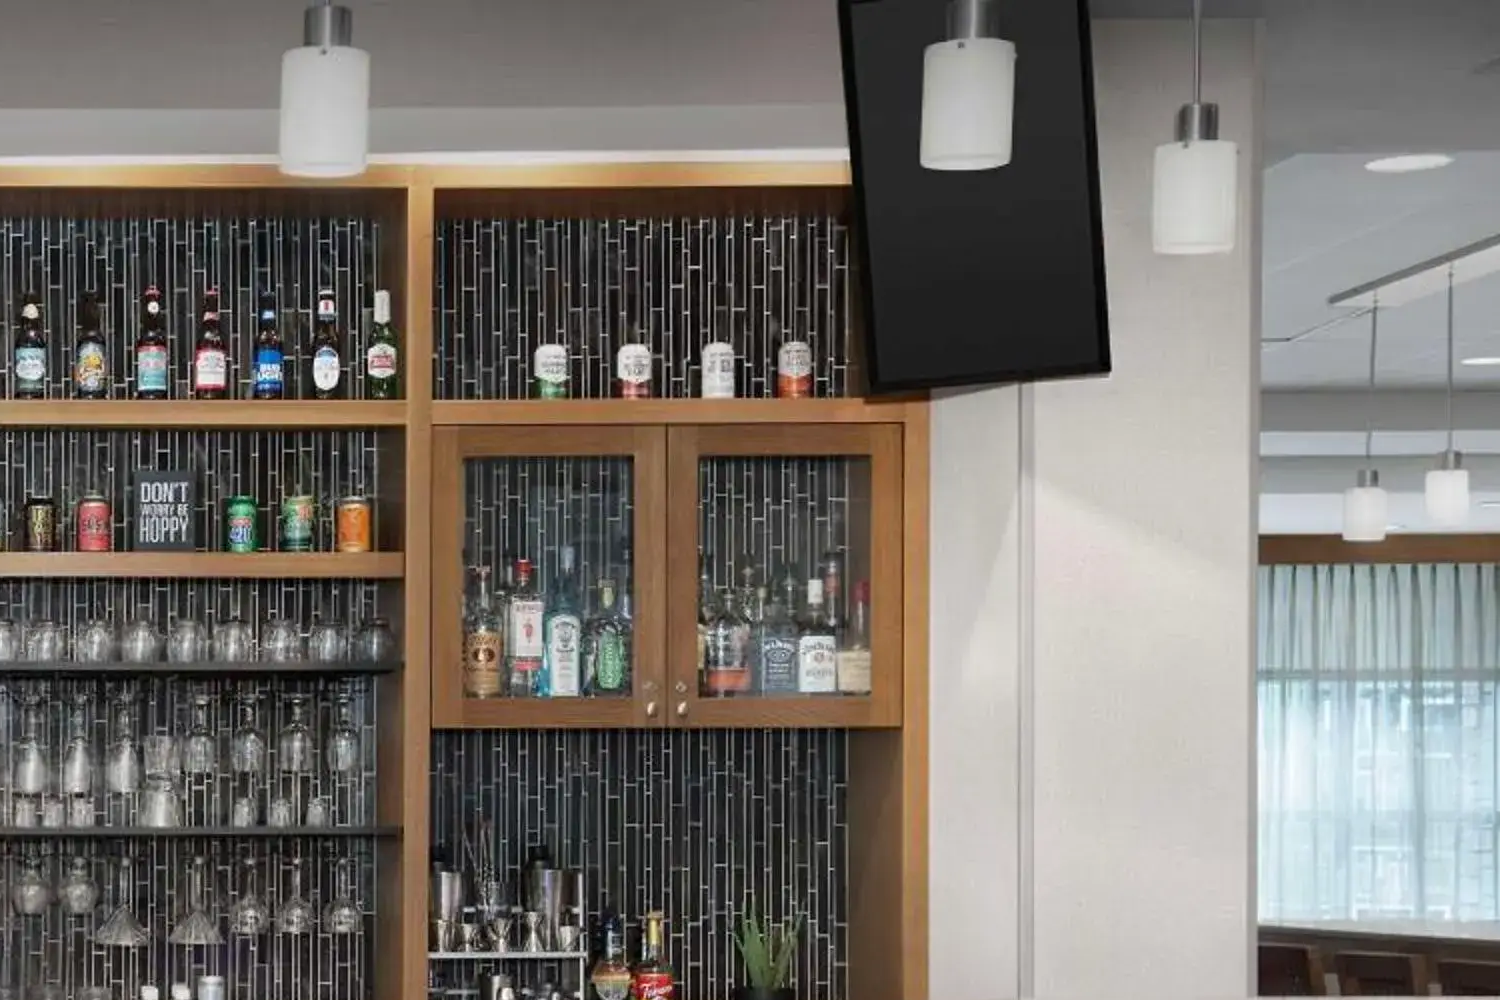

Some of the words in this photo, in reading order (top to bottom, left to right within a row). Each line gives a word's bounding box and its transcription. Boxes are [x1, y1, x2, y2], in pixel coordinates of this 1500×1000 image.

[141, 482, 189, 502] DON'T
[141, 504, 175, 517] WORRY
[140, 516, 188, 543] HOPPY
